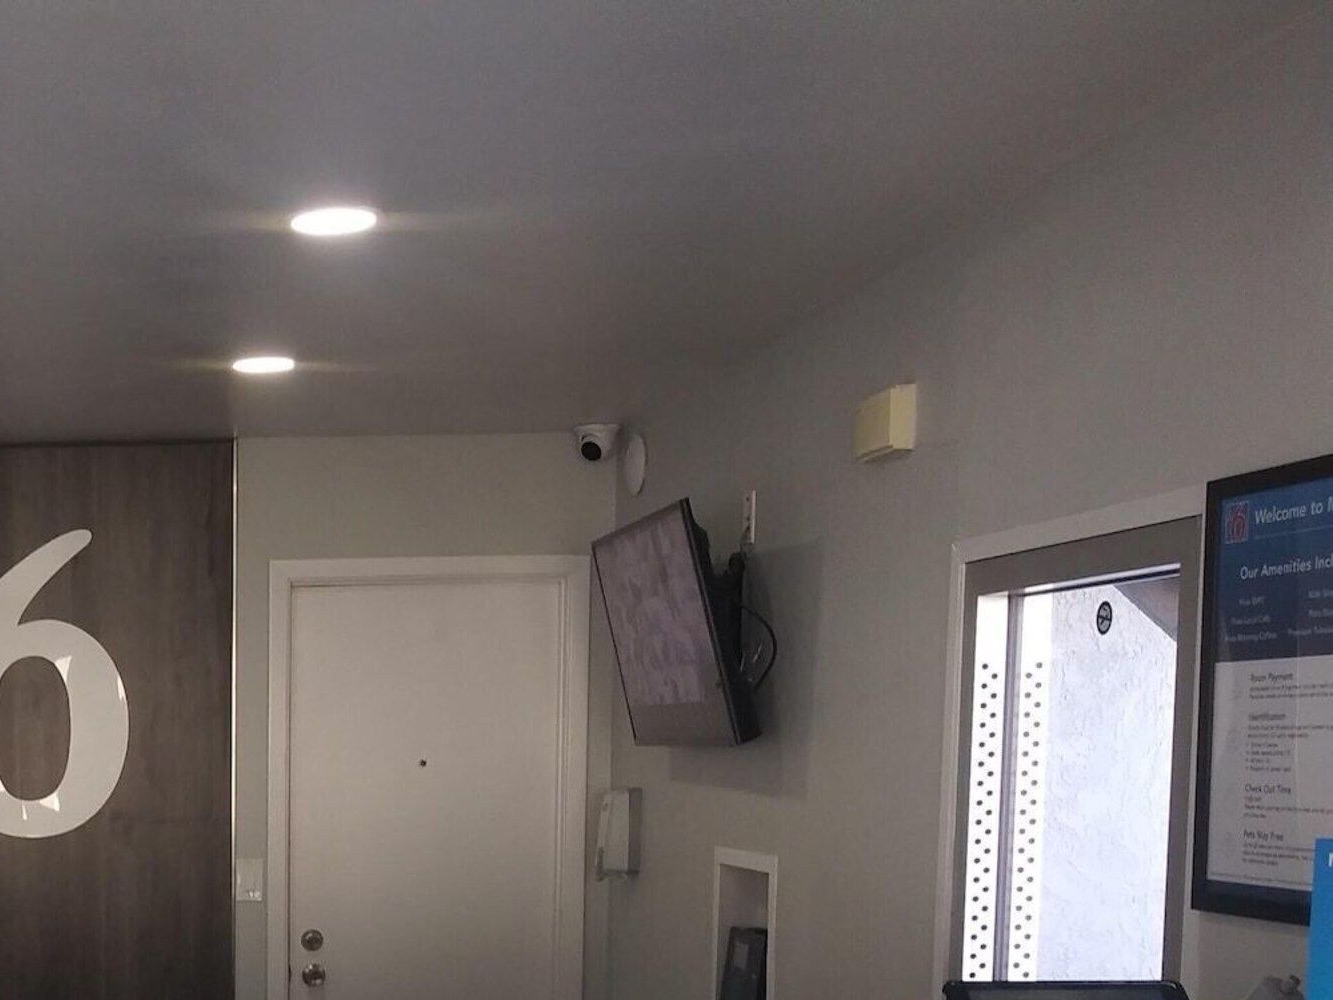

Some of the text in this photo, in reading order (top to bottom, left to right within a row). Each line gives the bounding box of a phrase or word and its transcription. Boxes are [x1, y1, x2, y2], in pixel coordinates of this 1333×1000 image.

[1255, 505, 1307, 524] Welcome
[1311, 502, 1323, 515] to
[1240, 566, 1258, 579] Our
[1261, 558, 1312, 577] Amenities
